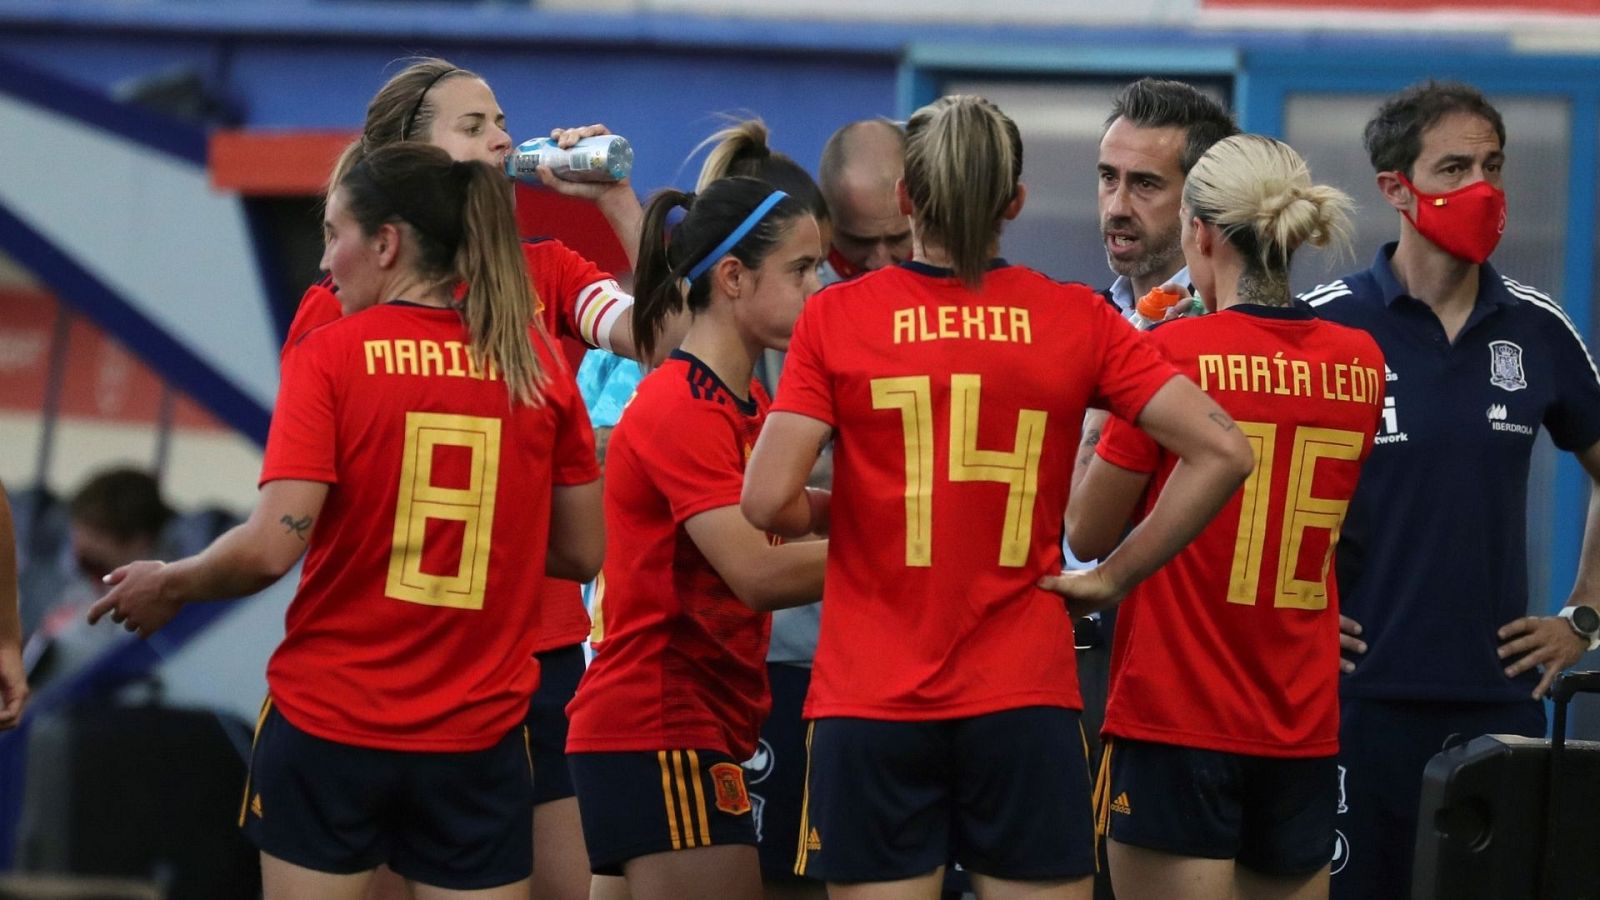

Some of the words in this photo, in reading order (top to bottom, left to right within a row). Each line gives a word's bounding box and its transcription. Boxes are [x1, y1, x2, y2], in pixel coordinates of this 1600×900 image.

[894, 306, 1032, 344] ALEXIA
[364, 339, 497, 381] MARIO
[1199, 352, 1311, 397] MARÍA
[1321, 357, 1379, 406] LEÓN
[1374, 432, 1408, 445] twork
[1492, 421, 1533, 434] IBERDROLA
[870, 373, 1048, 567] 14
[385, 411, 502, 610] 8
[1226, 420, 1365, 610] 16
